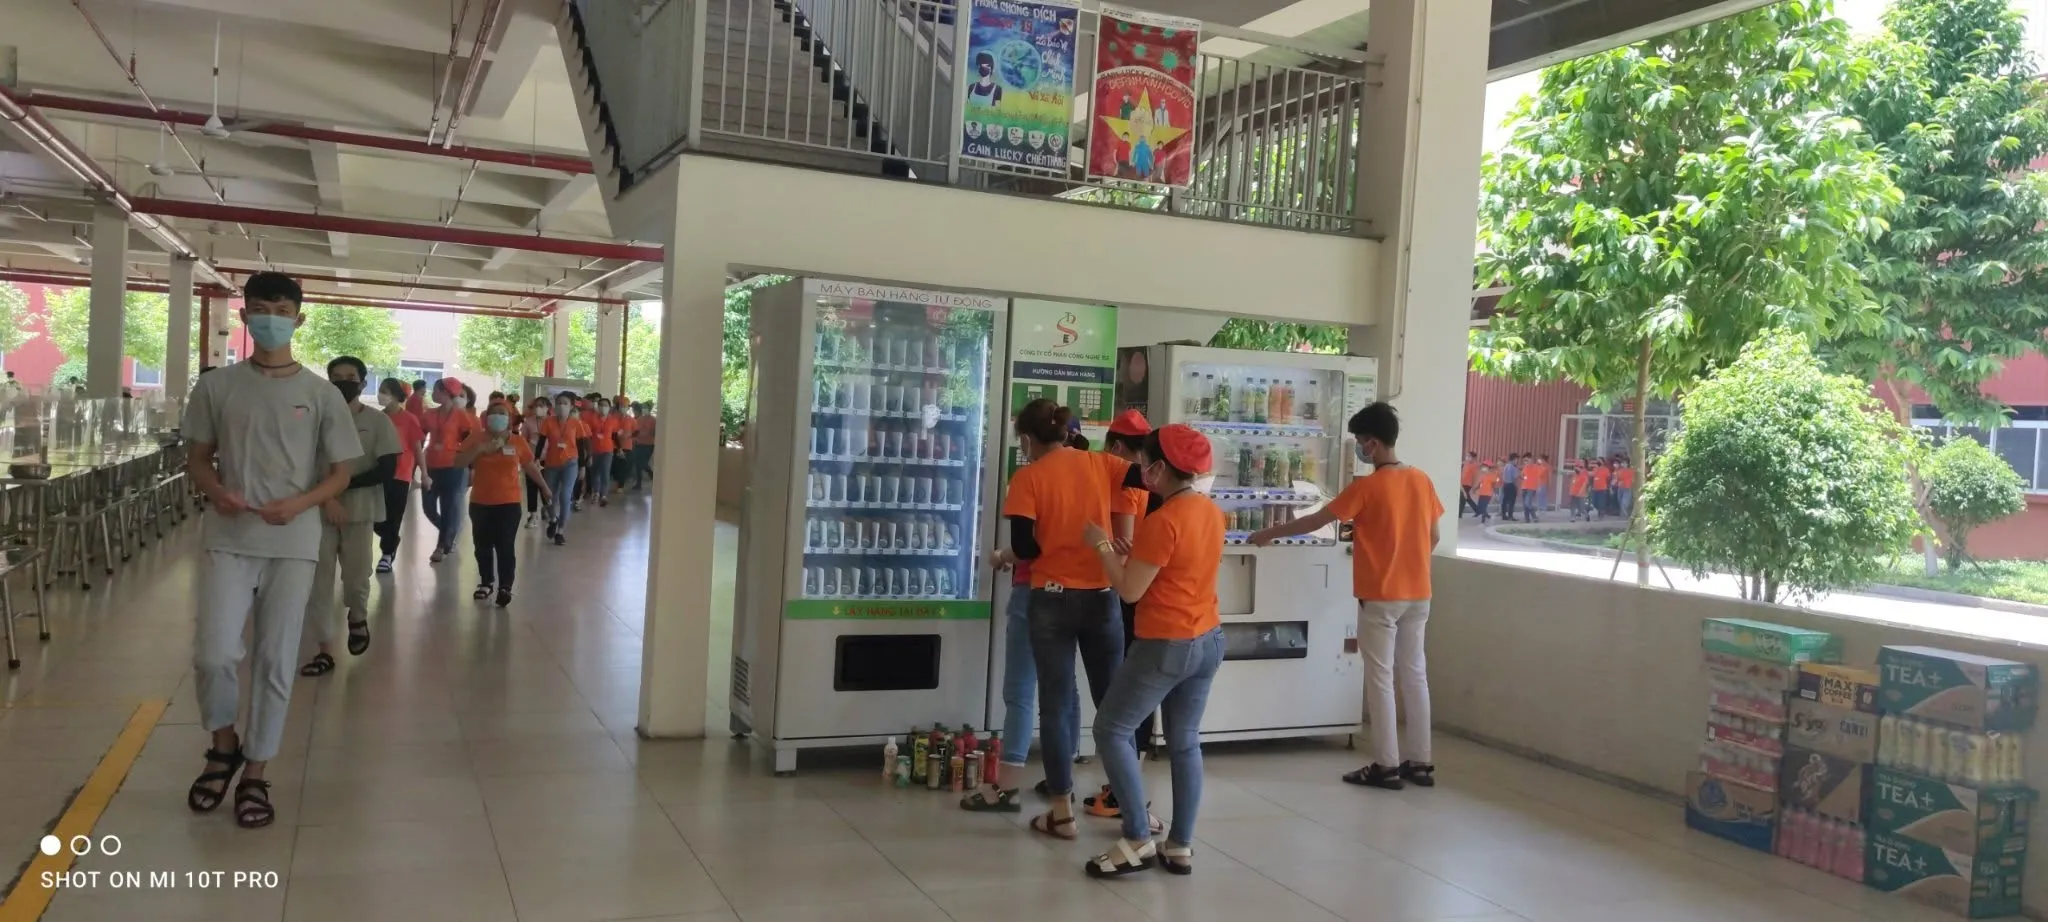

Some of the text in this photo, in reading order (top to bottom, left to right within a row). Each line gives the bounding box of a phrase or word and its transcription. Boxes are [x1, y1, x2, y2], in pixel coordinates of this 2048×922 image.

[967, 143, 991, 157] GAIN
[995, 147, 1023, 161] LUCKY
[1824, 676, 1853, 692] MAX
